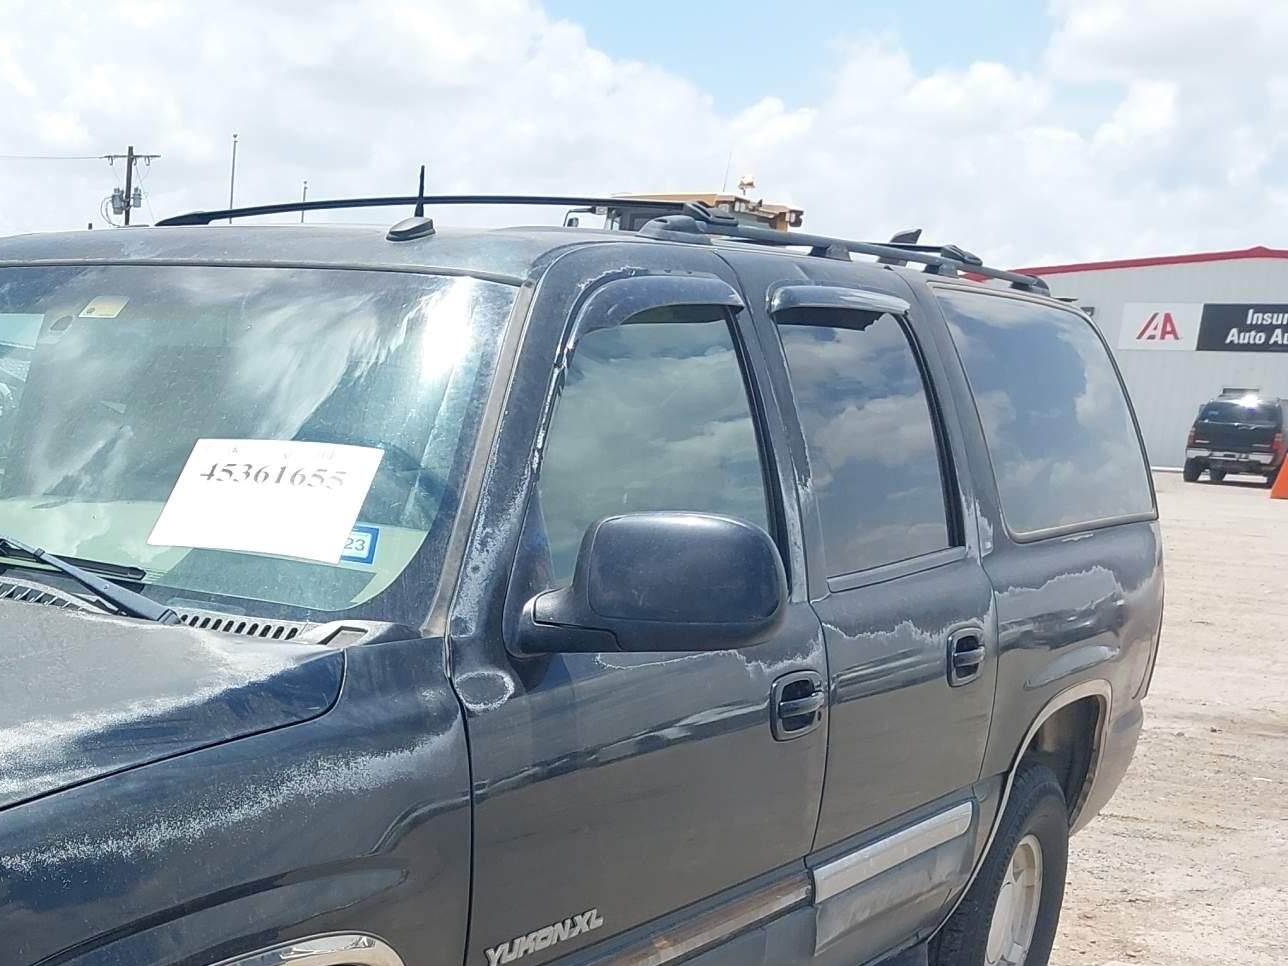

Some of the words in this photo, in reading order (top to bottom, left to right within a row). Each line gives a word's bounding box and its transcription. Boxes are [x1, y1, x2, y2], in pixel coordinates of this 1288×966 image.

[1224, 327, 1266, 345] Auto
[199, 462, 348, 490] 45361655
[343, 537, 366, 551] 23
[569, 907, 605, 936] XL
